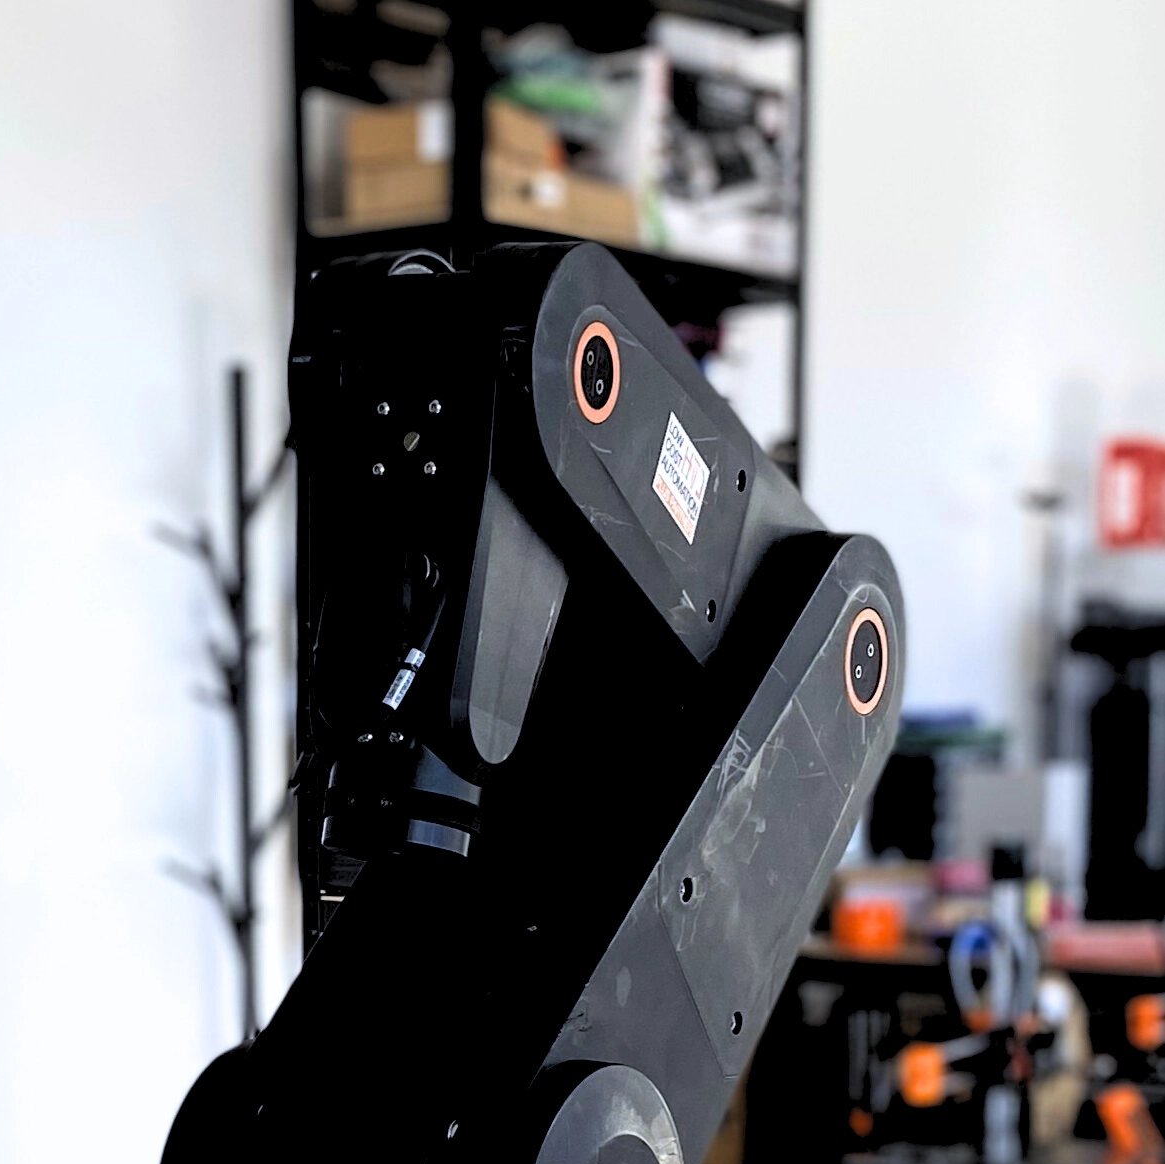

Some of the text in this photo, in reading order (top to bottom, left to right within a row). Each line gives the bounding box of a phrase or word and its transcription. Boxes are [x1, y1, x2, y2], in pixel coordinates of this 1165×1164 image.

[669, 421, 684, 448] LOW
[665, 437, 683, 466] COST
[661, 456, 699, 517] AUTOMATION
